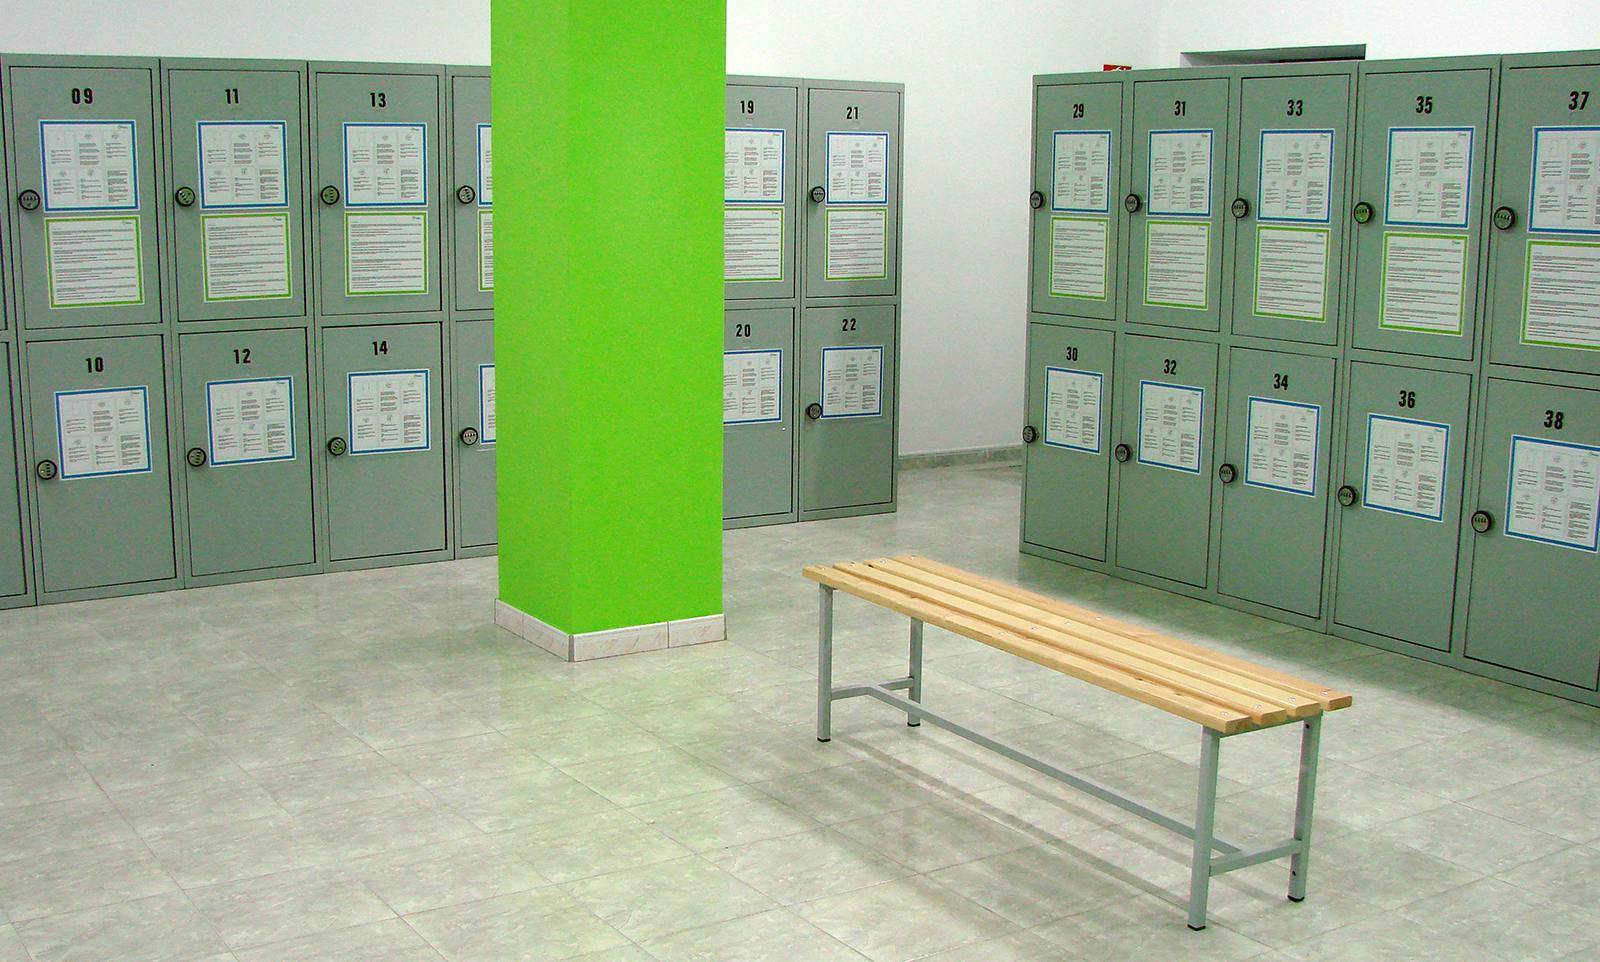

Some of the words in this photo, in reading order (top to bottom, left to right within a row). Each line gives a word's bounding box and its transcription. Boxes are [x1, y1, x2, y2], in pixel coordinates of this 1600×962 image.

[71, 87, 93, 105] 09
[224, 88, 239, 105] 11
[369, 92, 387, 108] 13
[1568, 90, 1590, 111] 37
[739, 99, 754, 115] 19
[846, 106, 859, 120] 21
[1072, 103, 1085, 119] 29
[1174, 100, 1187, 117] 31
[1286, 99, 1304, 117] 33
[1415, 95, 1433, 115] 35
[735, 323, 751, 338] 20
[841, 317, 857, 332] 22
[233, 348, 252, 365] 12
[371, 340, 389, 356] 14
[1065, 346, 1079, 362] 30
[85, 356, 104, 374] 10
[1163, 358, 1177, 376] 32
[1273, 372, 1289, 391] 34
[1398, 389, 1416, 409] 36
[1543, 409, 1565, 431] 38
